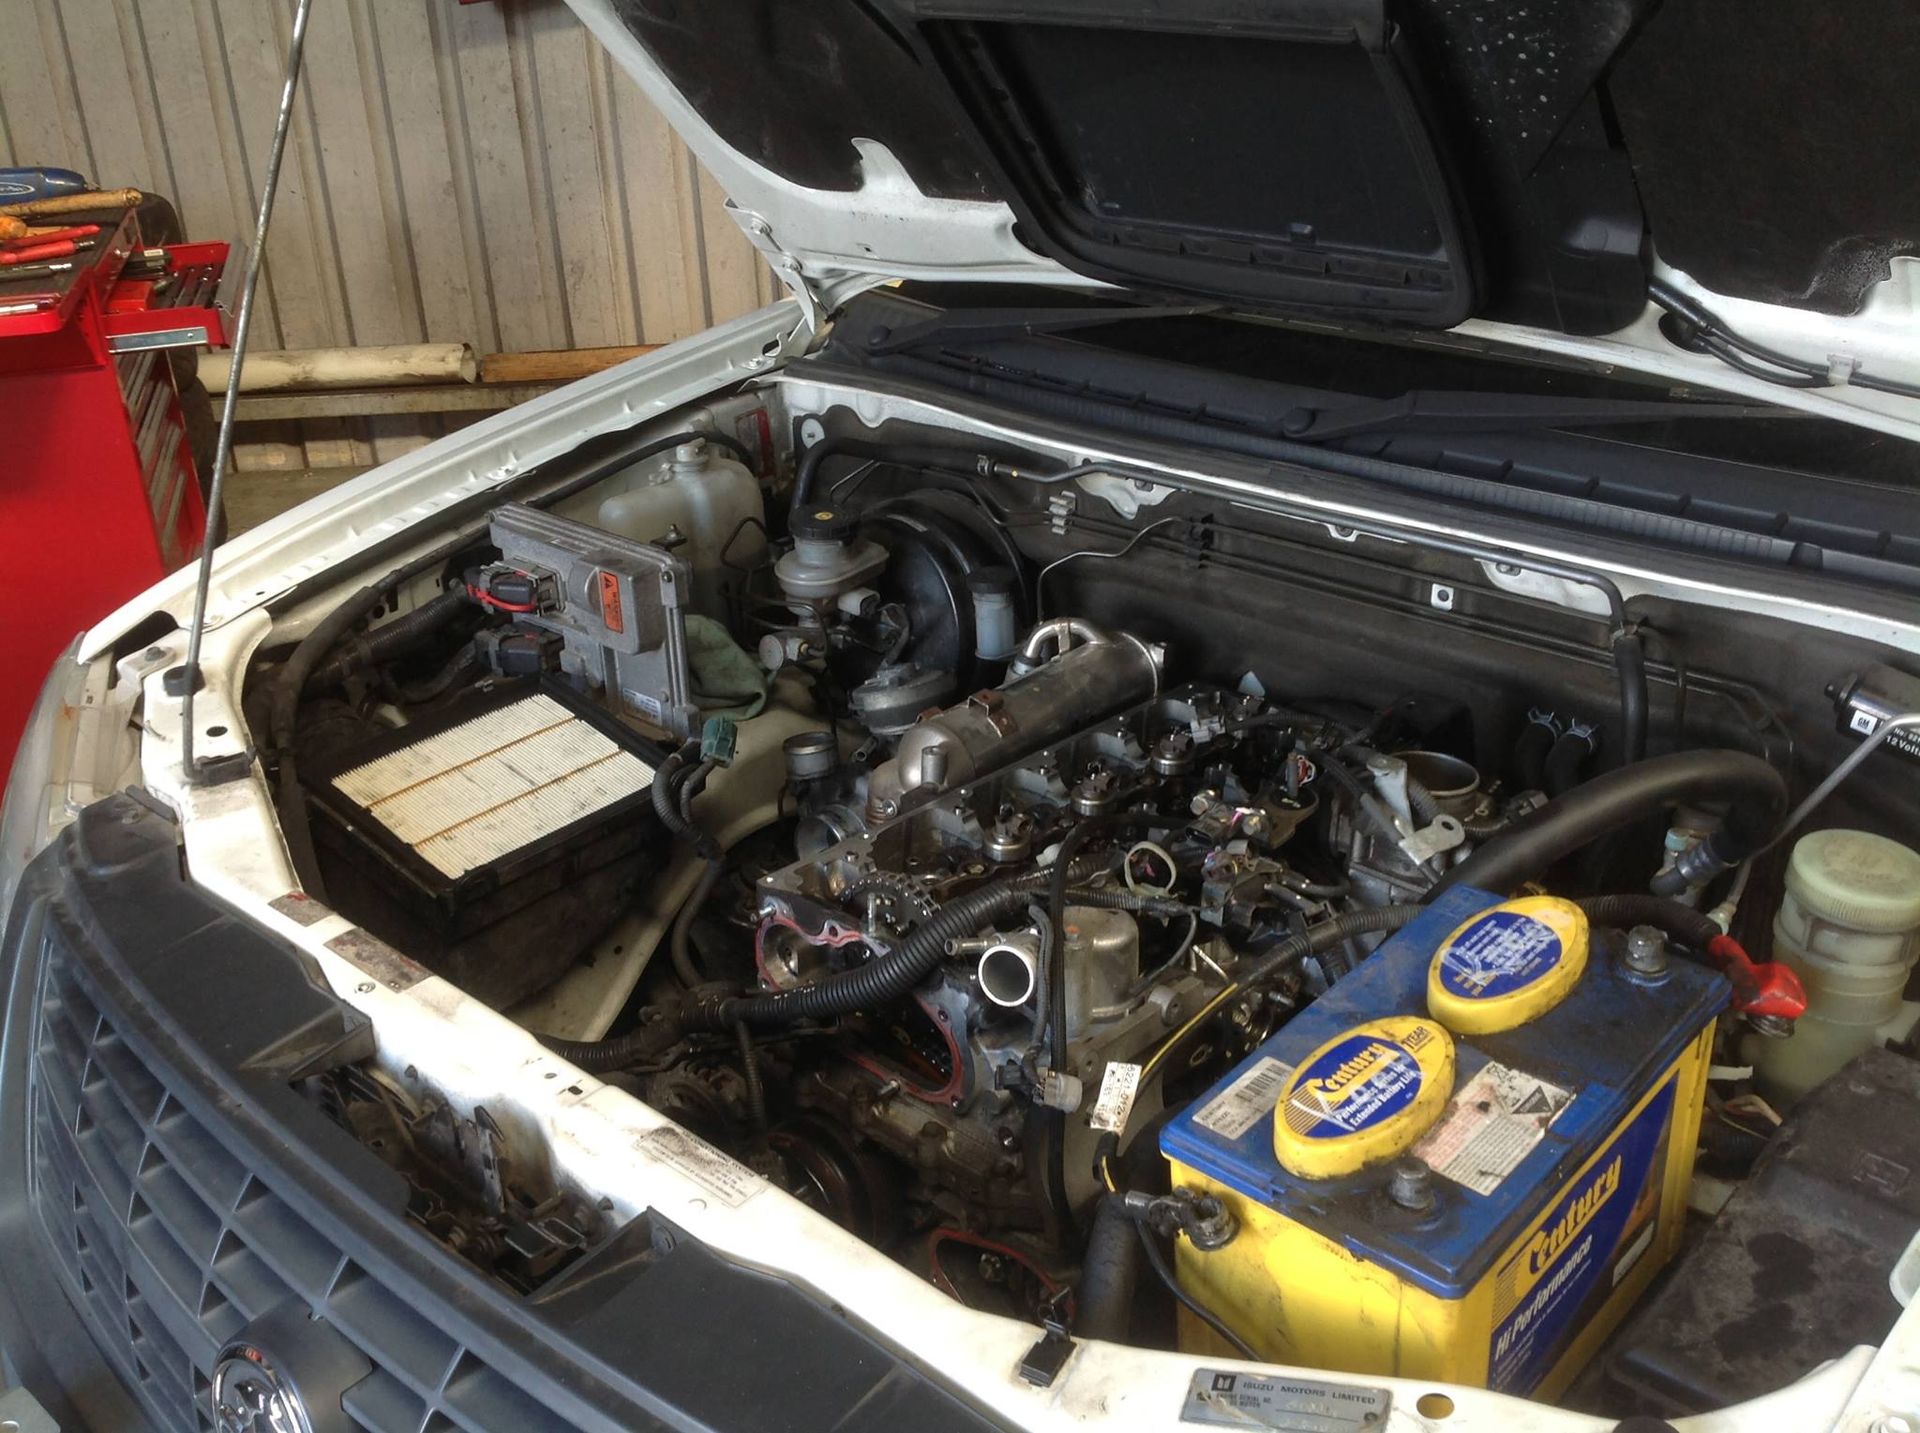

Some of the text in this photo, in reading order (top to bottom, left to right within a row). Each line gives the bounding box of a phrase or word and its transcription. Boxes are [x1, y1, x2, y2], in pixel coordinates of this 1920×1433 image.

[1306, 1042, 1400, 1101] Century
[1518, 1155, 1621, 1296] Century
[1512, 1234, 1593, 1342] Performance
[1243, 1382, 1376, 1405] ISUZU MOTORS LIMITED
